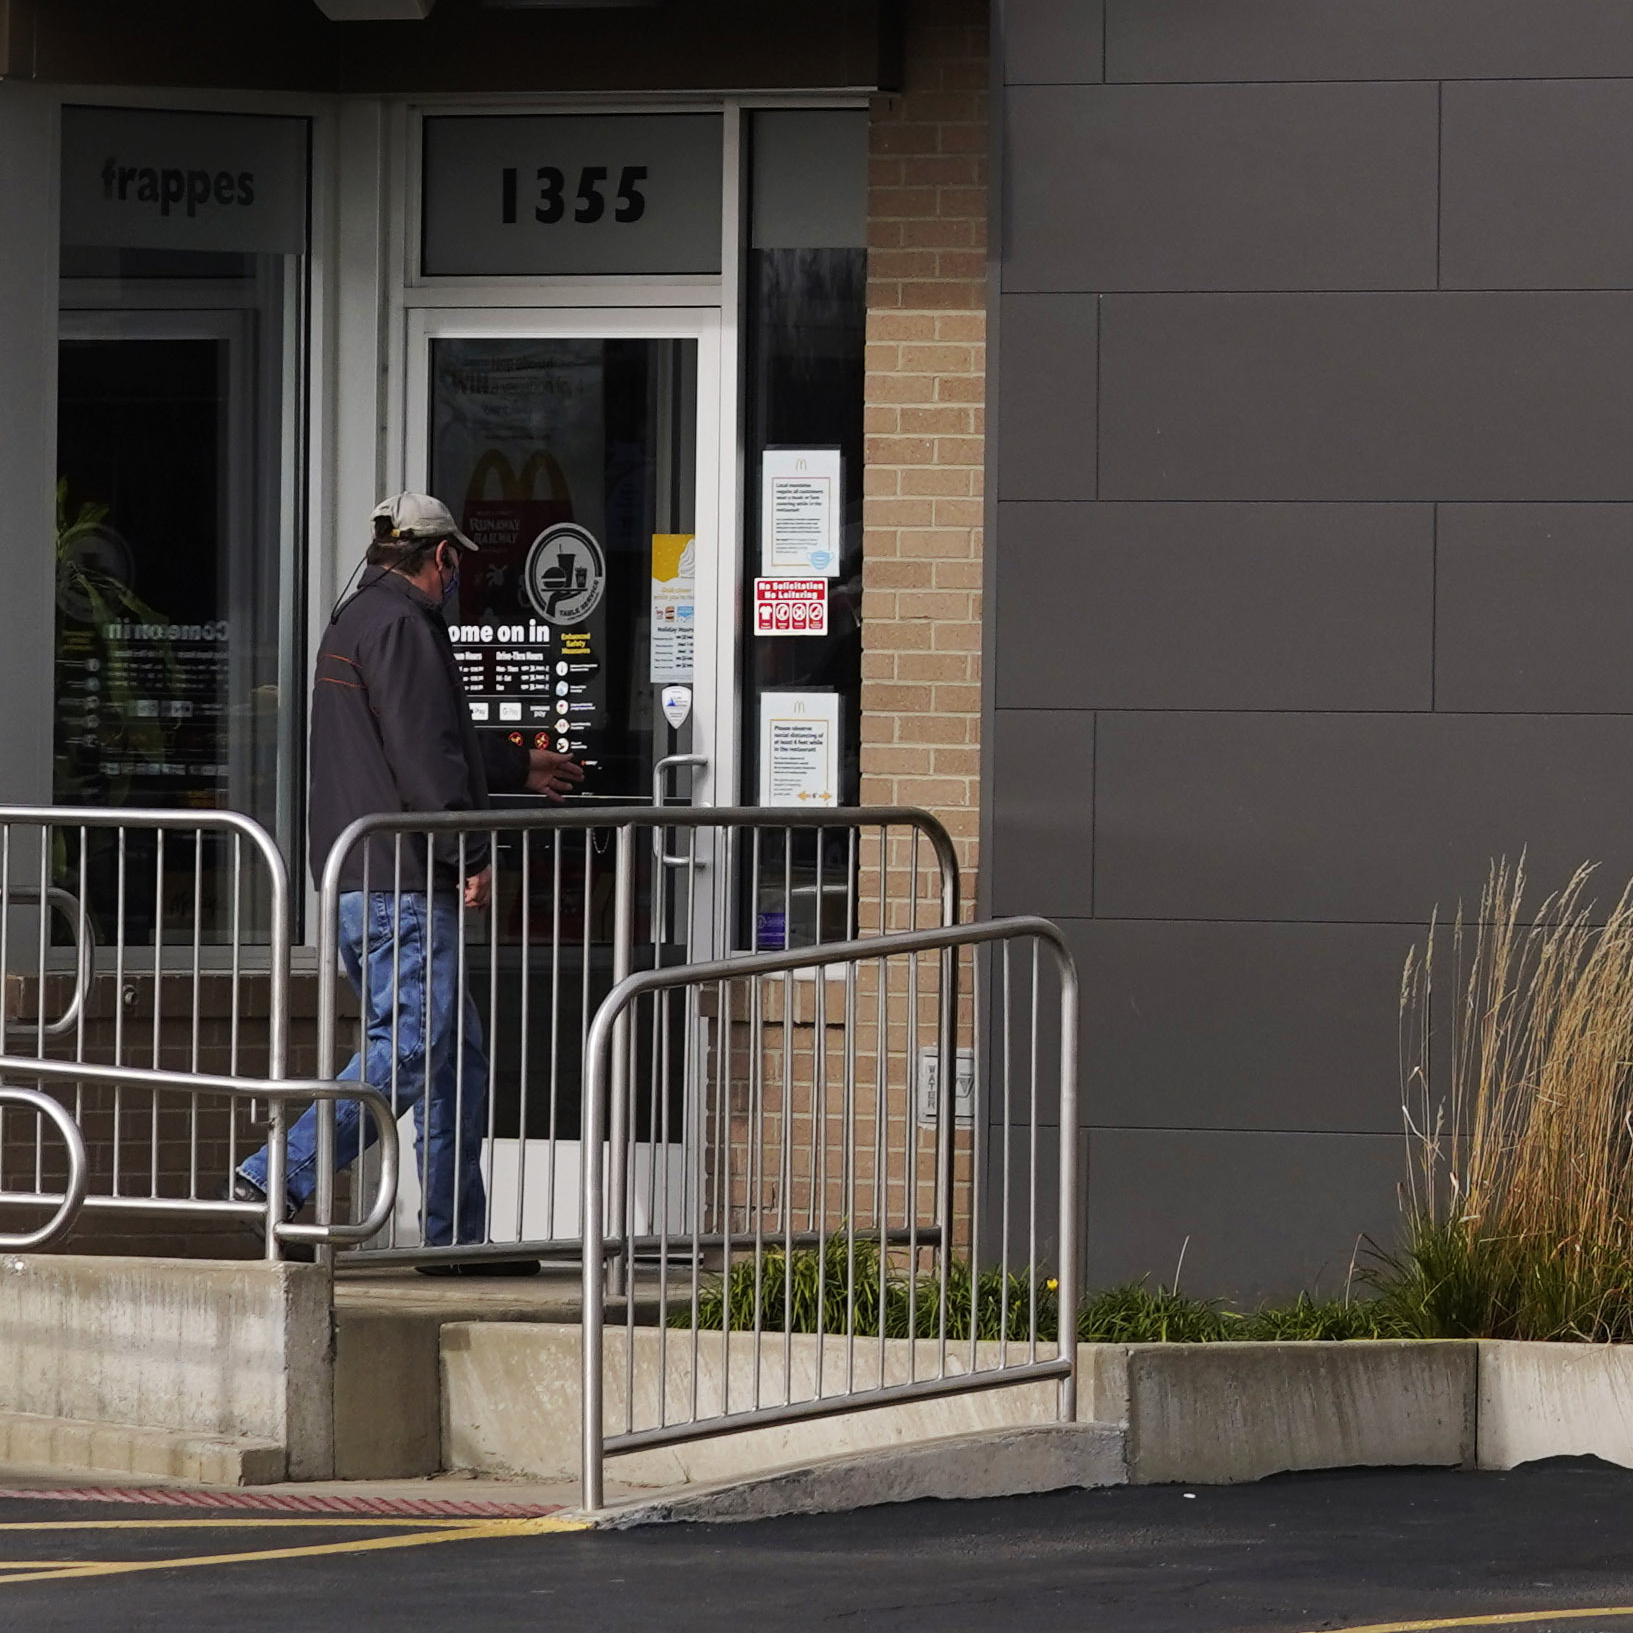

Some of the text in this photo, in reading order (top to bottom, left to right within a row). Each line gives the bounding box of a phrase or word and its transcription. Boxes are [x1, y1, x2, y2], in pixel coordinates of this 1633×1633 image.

[101, 156, 256, 218] frappes
[500, 164, 649, 226] 1355
[759, 582, 771, 590] No
[764, 591, 776, 599] No
[448, 618, 550, 643] ome on in
[927, 1064, 937, 1109] WATER
